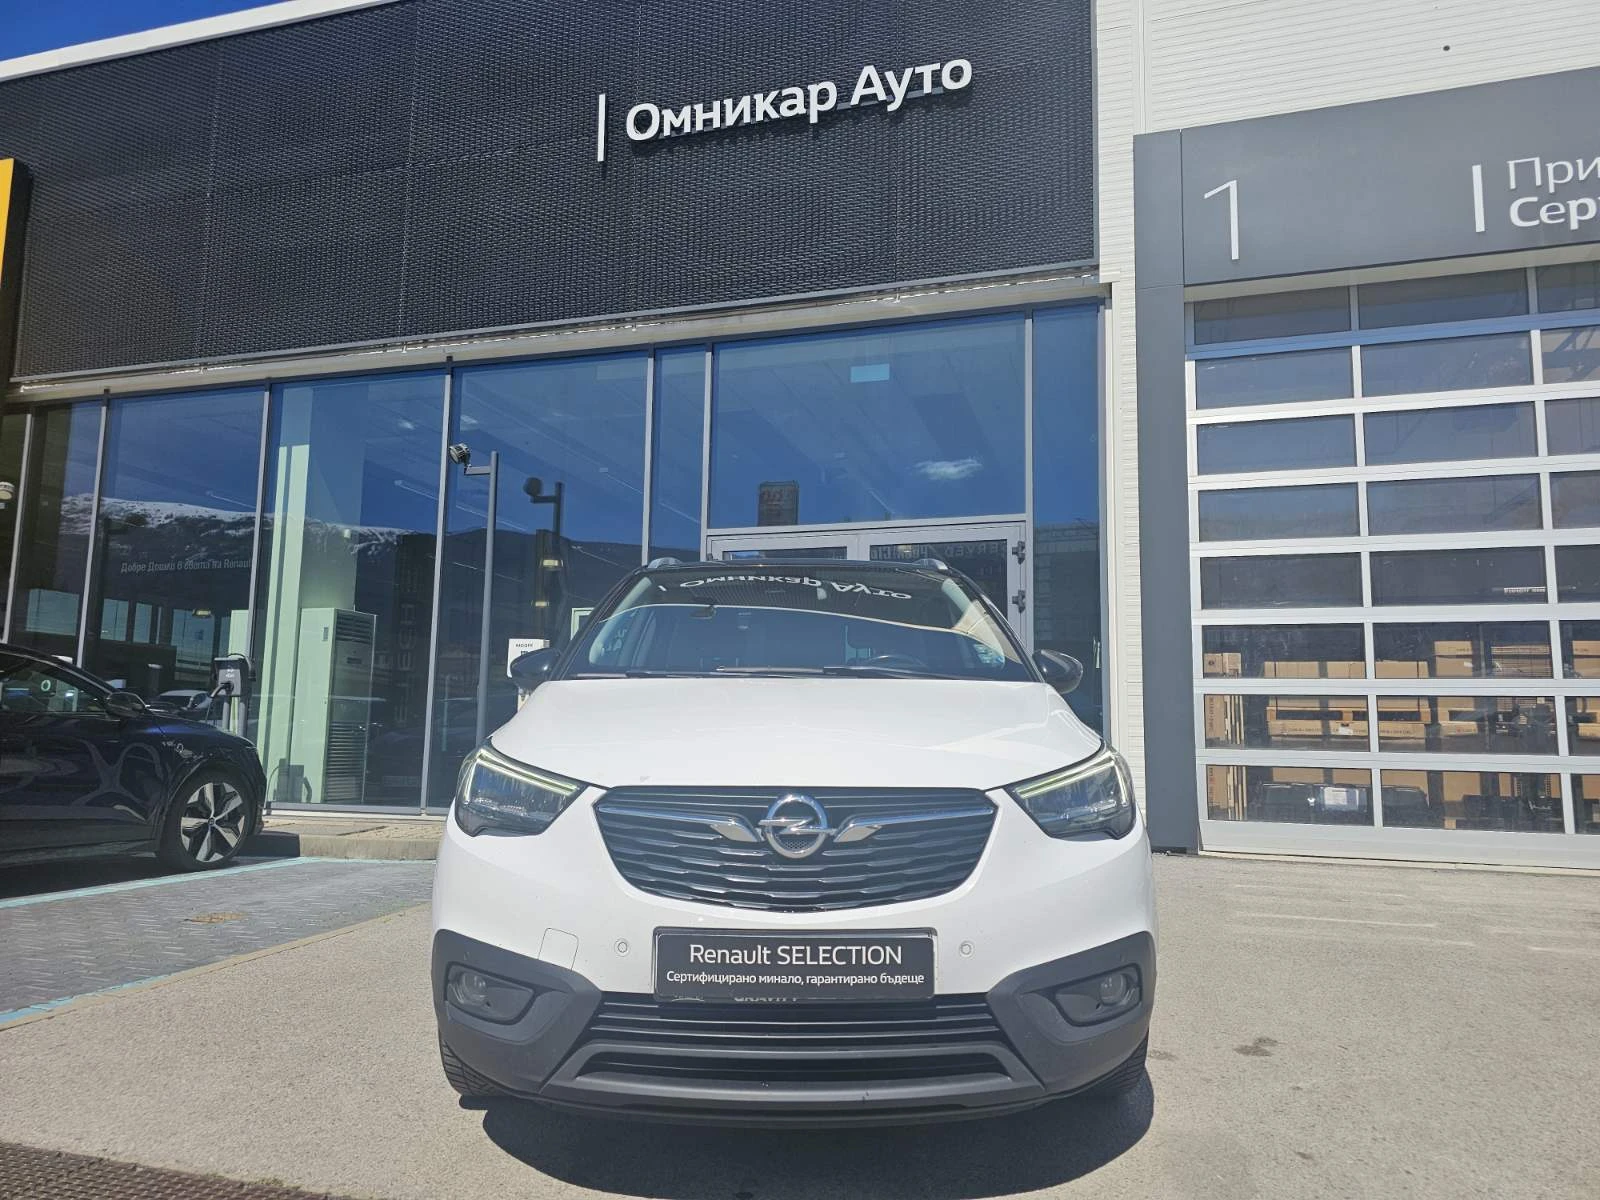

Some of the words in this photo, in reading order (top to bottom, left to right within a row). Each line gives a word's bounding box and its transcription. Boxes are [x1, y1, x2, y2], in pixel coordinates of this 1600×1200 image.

[625, 79, 838, 142] Омникар
[850, 58, 973, 111] Ауто
[1506, 156, 1600, 193] При
[1204, 180, 1240, 260] 1
[1509, 196, 1600, 230] Сер
[689, 944, 772, 965] Renault
[777, 945, 902, 966] SELECTION
[666, 970, 757, 985] Сертифицирано
[758, 974, 805, 985] минало,
[806, 975, 878, 986] гарантирано
[880, 973, 925, 985] бъдеще
